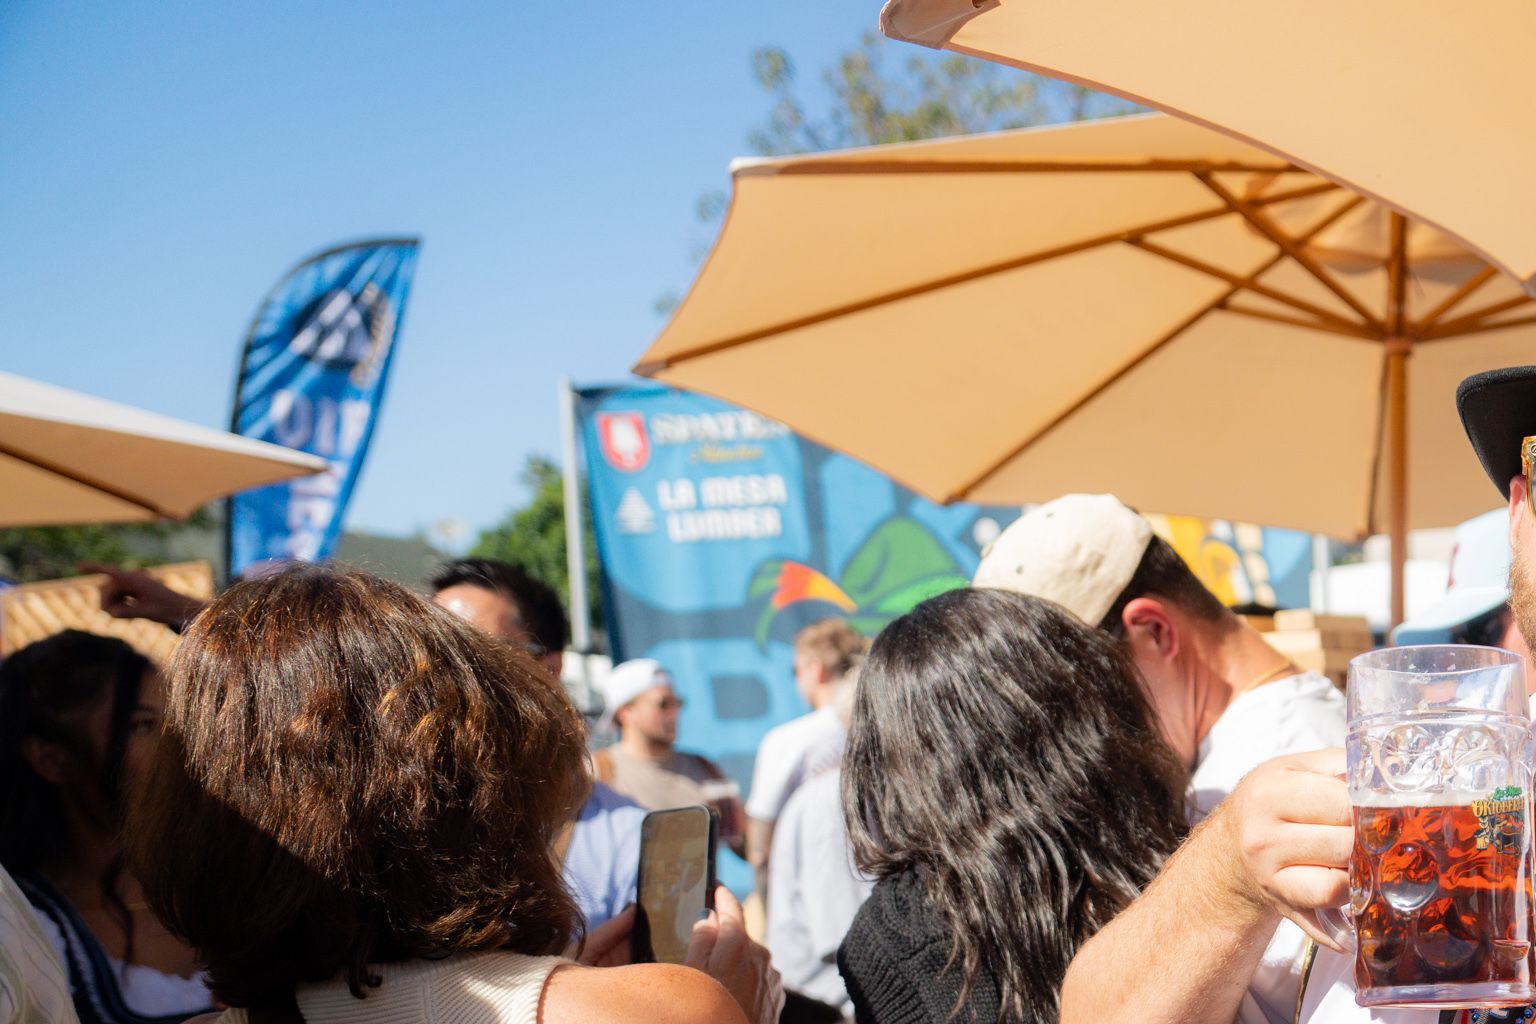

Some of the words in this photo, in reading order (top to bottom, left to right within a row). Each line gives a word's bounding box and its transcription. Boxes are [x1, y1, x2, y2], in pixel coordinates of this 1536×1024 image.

[657, 477, 697, 511] LA
[701, 473, 788, 508] MESA
[667, 505, 783, 543] LUMBER
